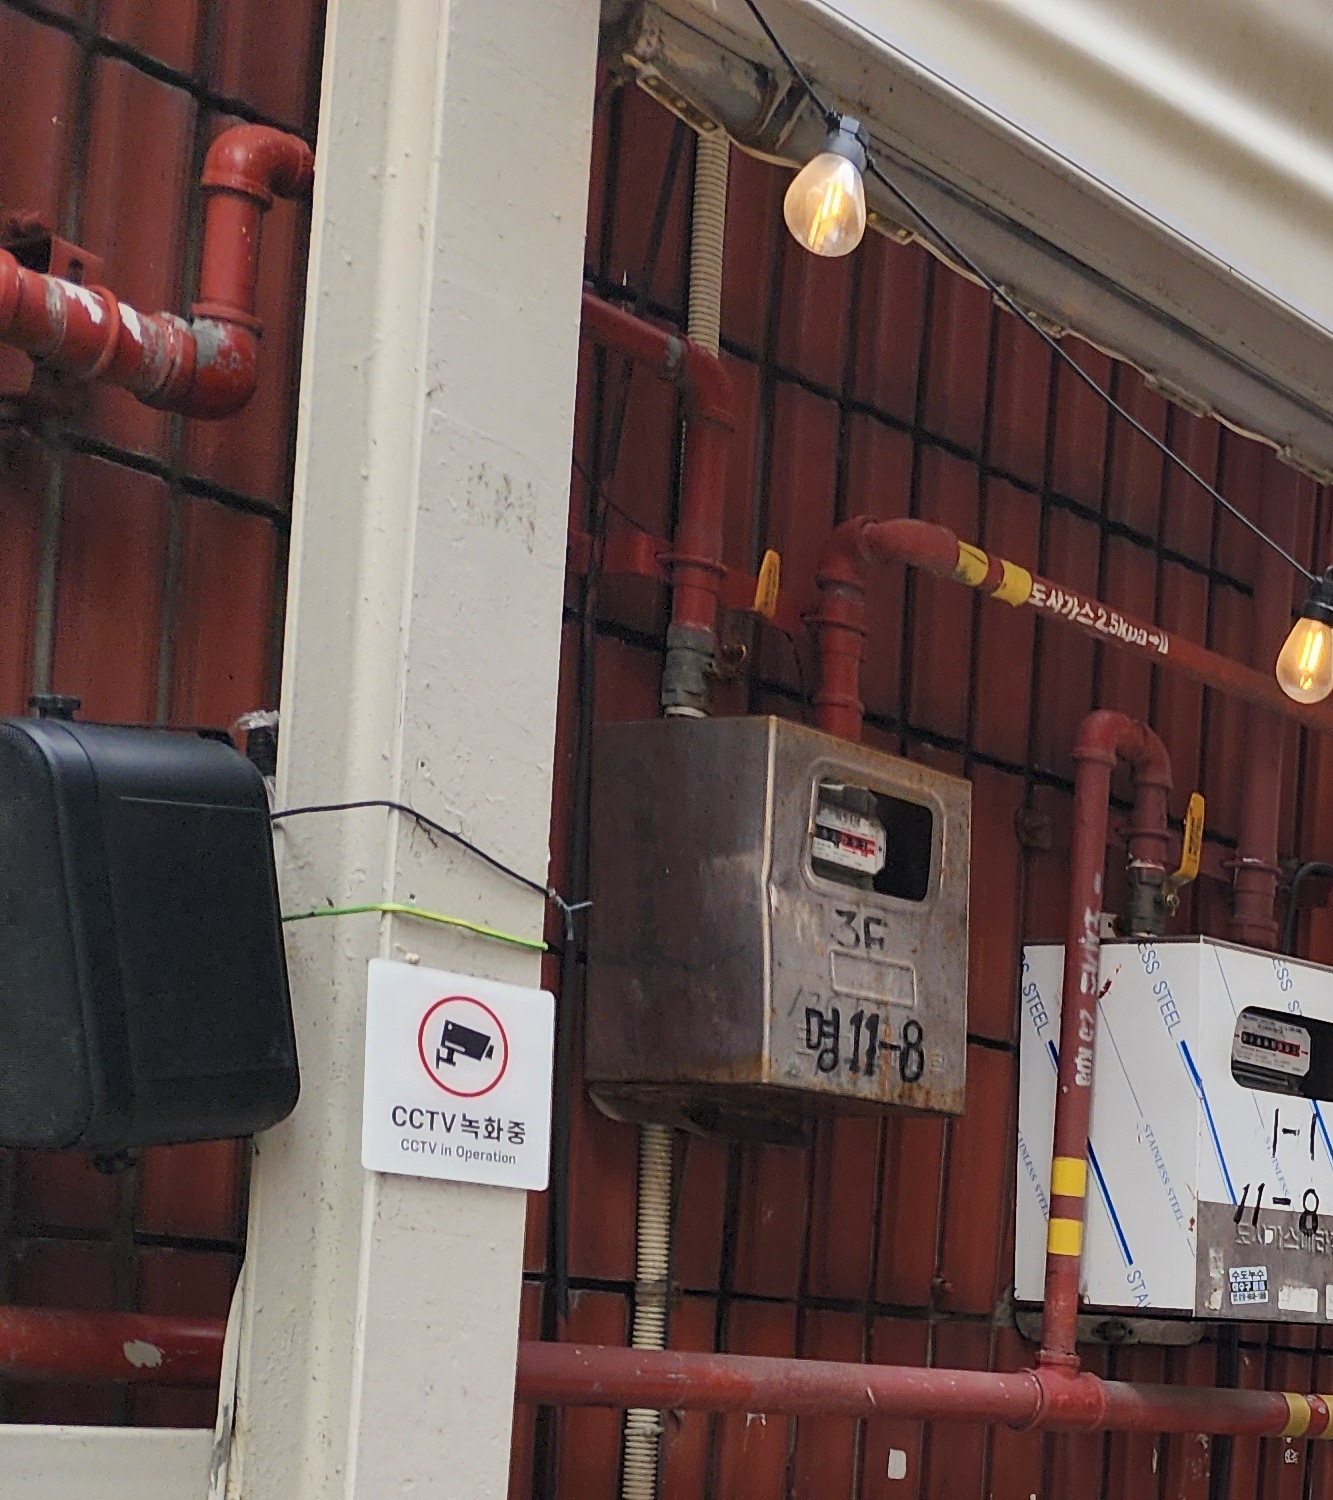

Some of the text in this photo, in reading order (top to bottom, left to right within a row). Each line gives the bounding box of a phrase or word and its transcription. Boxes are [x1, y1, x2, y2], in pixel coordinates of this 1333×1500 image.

[1023, 981, 1050, 1037] STEEL
[1153, 980, 1182, 1036] STEEL
[391, 1105, 456, 1133] CCTV
[400, 1138, 517, 1165] CCTV in Operation
